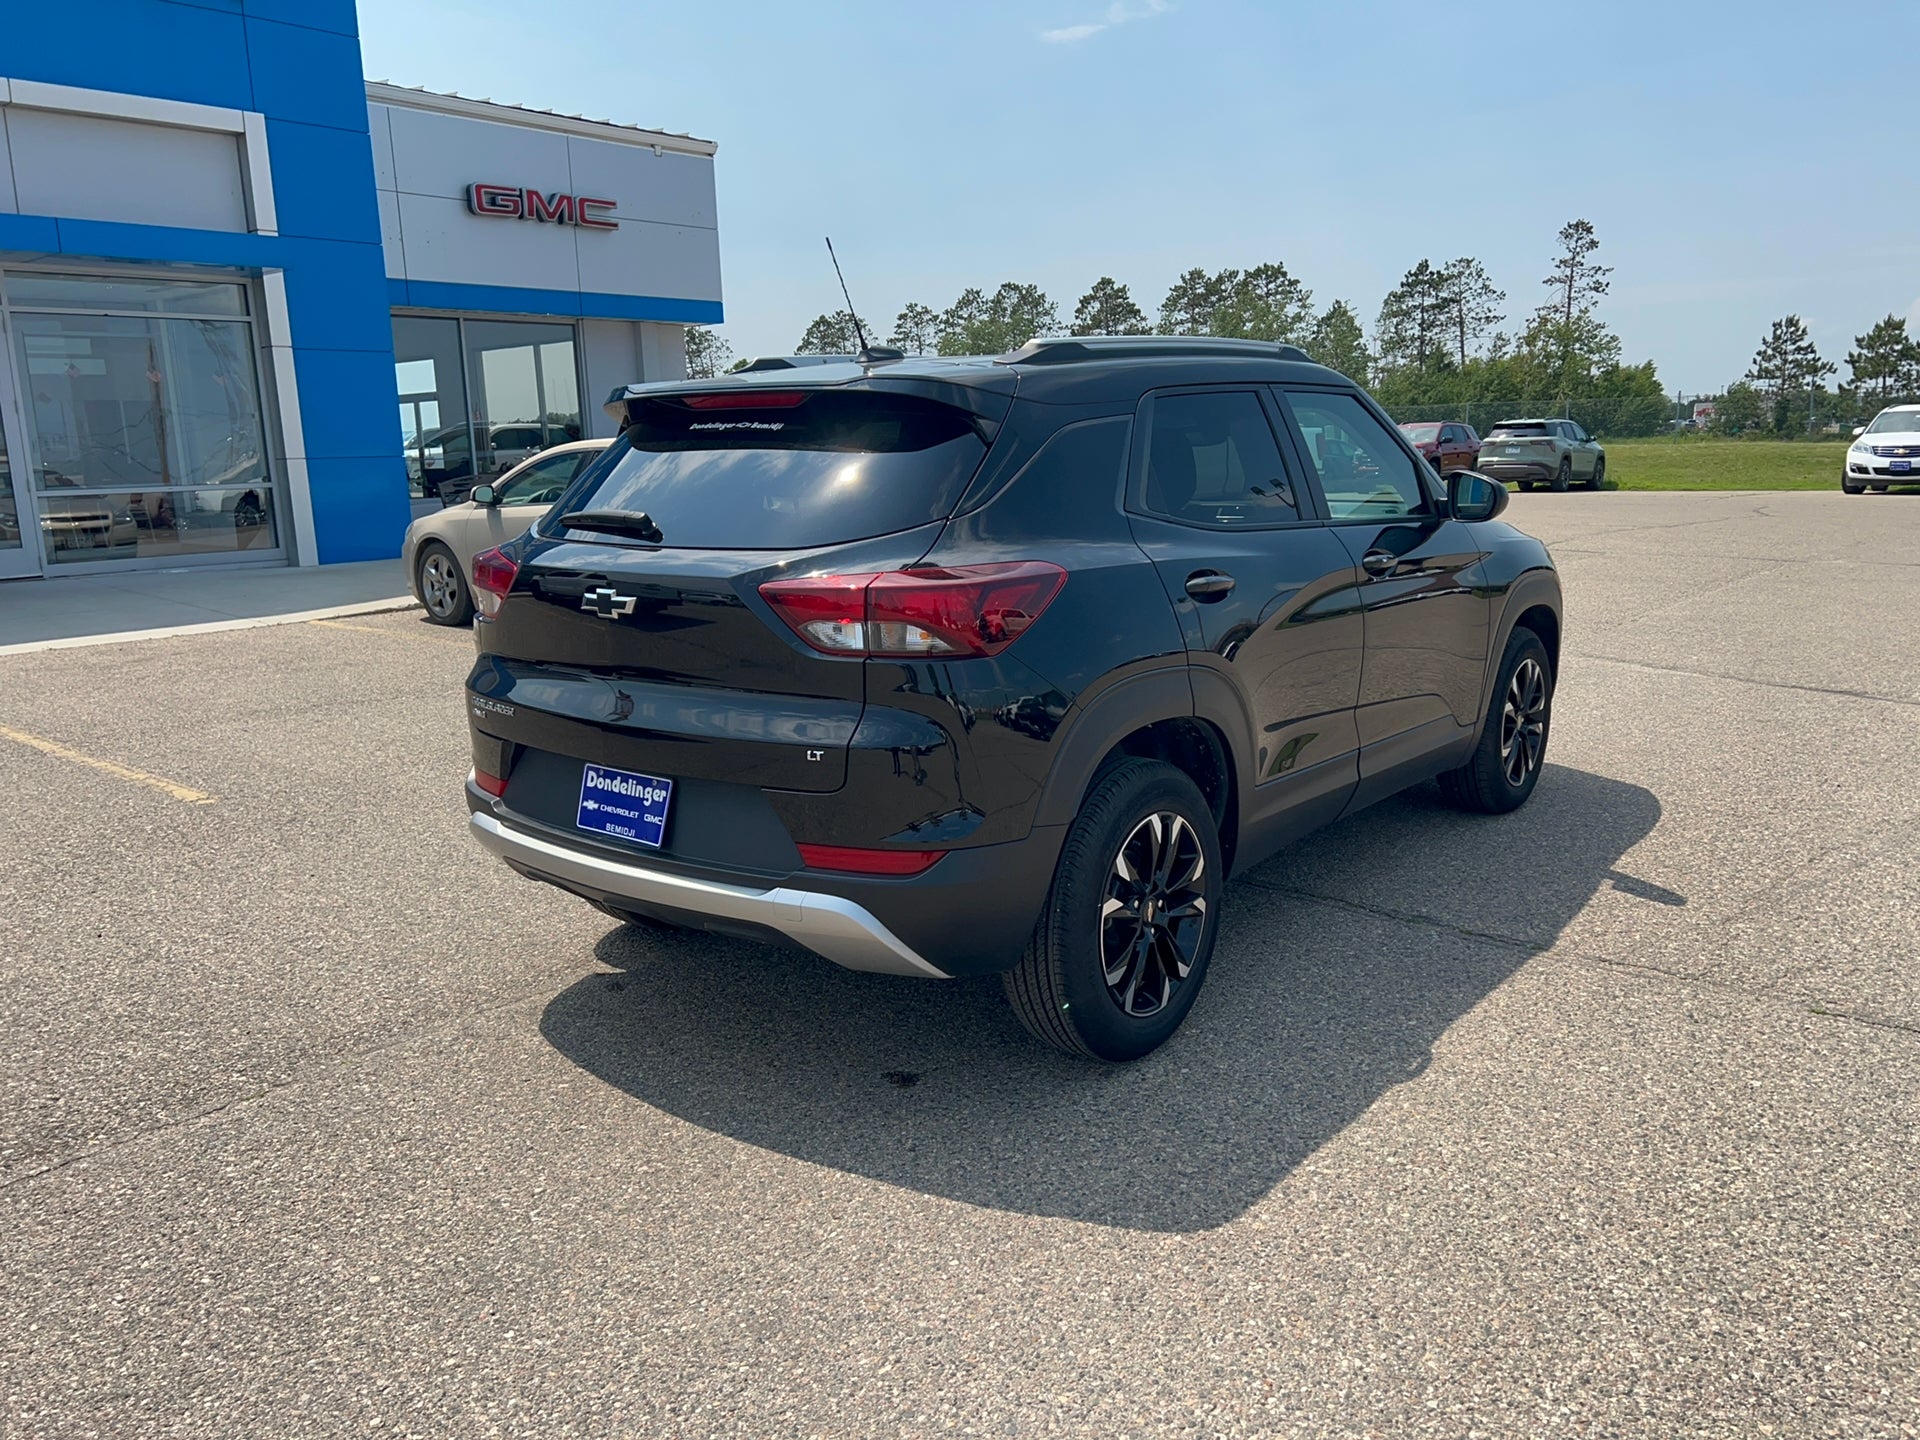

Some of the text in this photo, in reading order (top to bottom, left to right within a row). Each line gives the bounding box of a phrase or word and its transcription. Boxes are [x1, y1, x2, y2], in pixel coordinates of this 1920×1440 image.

[467, 183, 619, 230] GMC
[807, 750, 824, 761] LT
[586, 770, 667, 806] Dondelinger
[600, 804, 663, 825] CHEVROLET GMC
[605, 823, 636, 837] BEMIDJI
